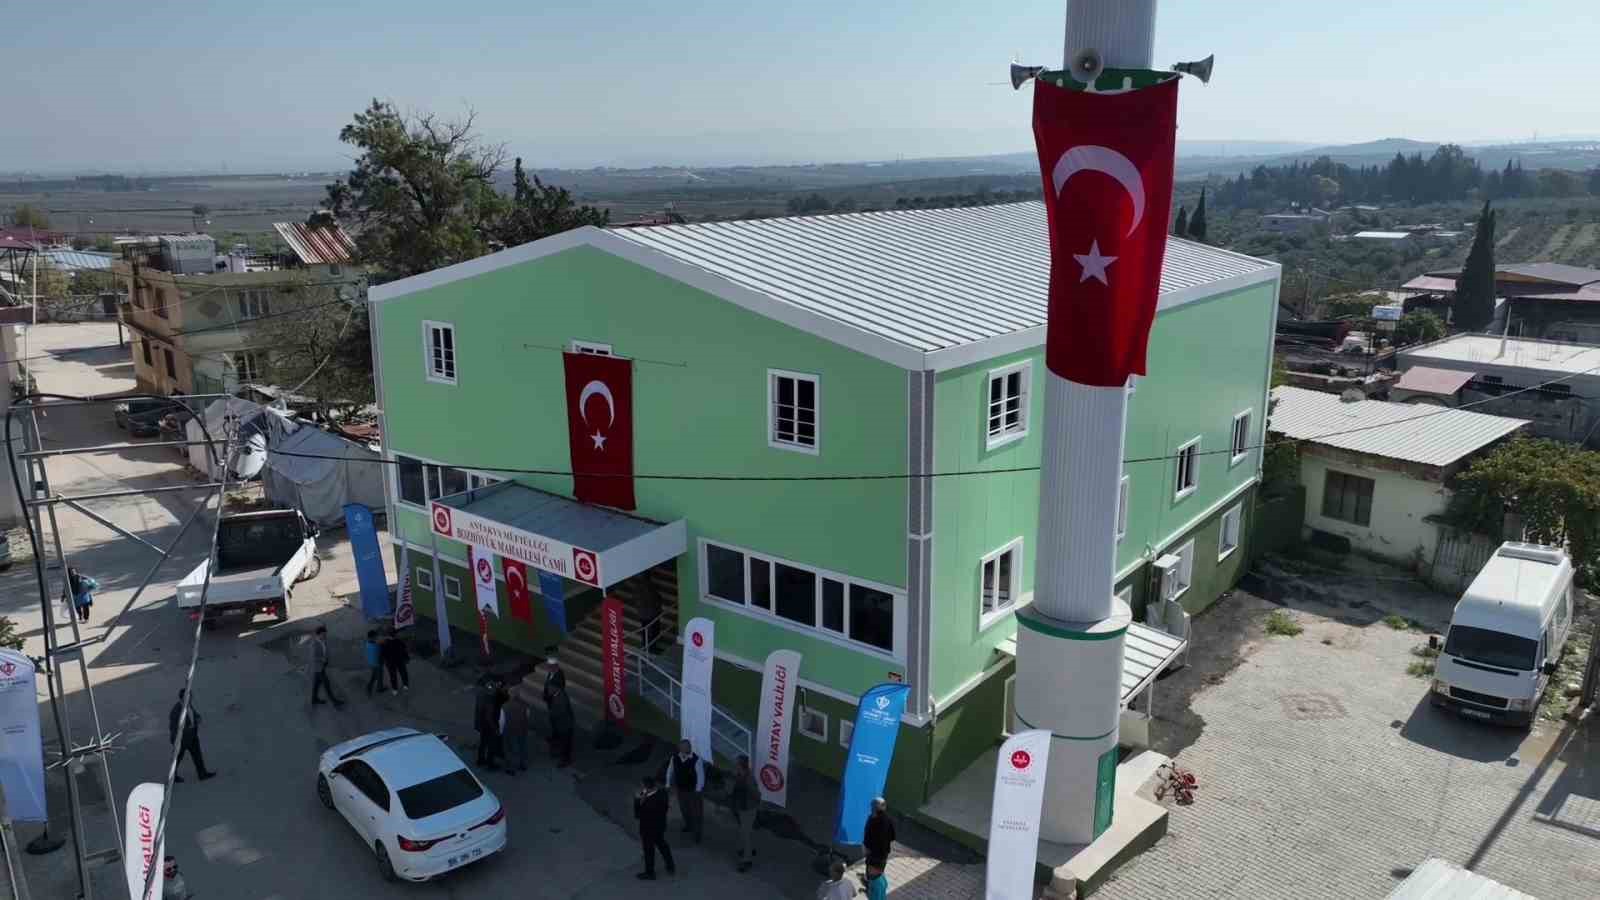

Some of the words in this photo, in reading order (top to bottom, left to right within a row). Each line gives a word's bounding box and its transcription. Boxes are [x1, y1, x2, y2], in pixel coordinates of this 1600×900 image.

[470, 520, 502, 538] ANTAKYA
[773, 664, 787, 718] VALİLİĞİ
[769, 718, 784, 761] HATAY
